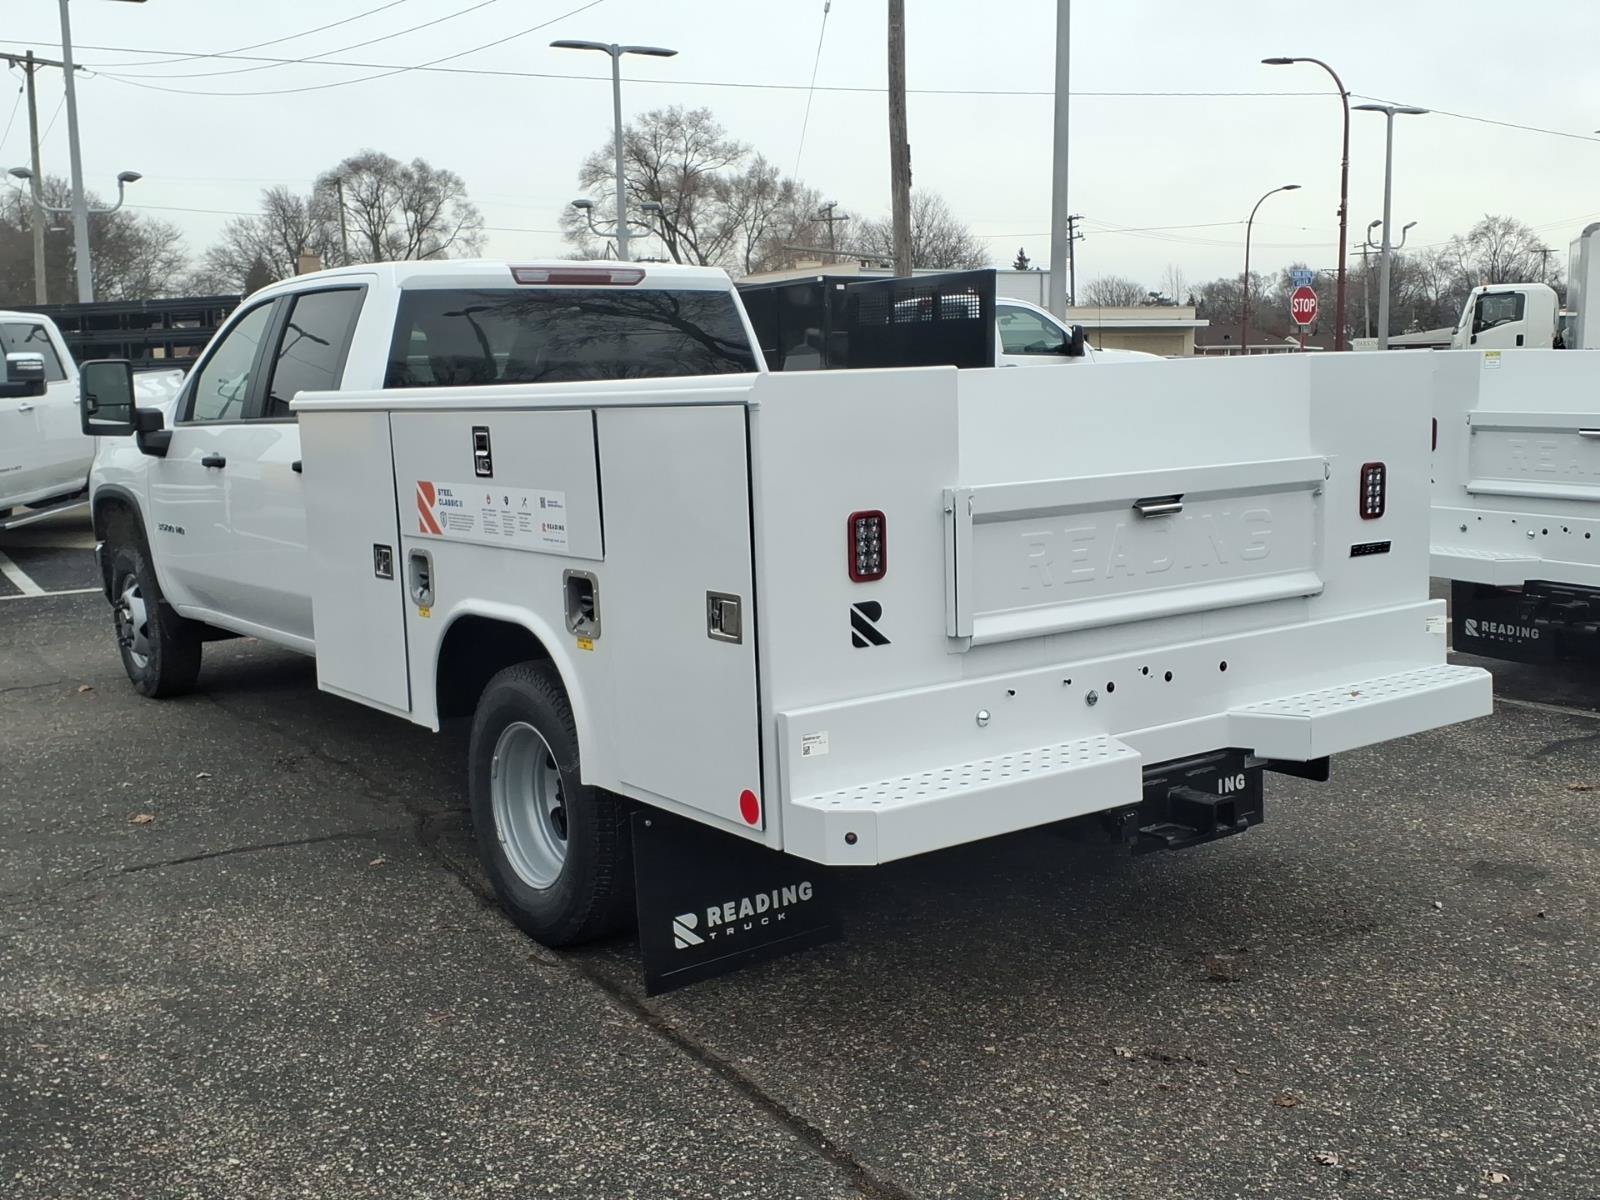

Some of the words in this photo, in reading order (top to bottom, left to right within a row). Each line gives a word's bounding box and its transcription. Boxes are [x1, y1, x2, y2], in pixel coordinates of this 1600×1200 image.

[1294, 299, 1315, 312] STOP
[438, 498, 458, 508] CLASSIC
[1020, 508, 1273, 590] READING
[1481, 621, 1540, 639] READING
[707, 881, 813, 927] READING
[709, 912, 786, 939] TRUCK
